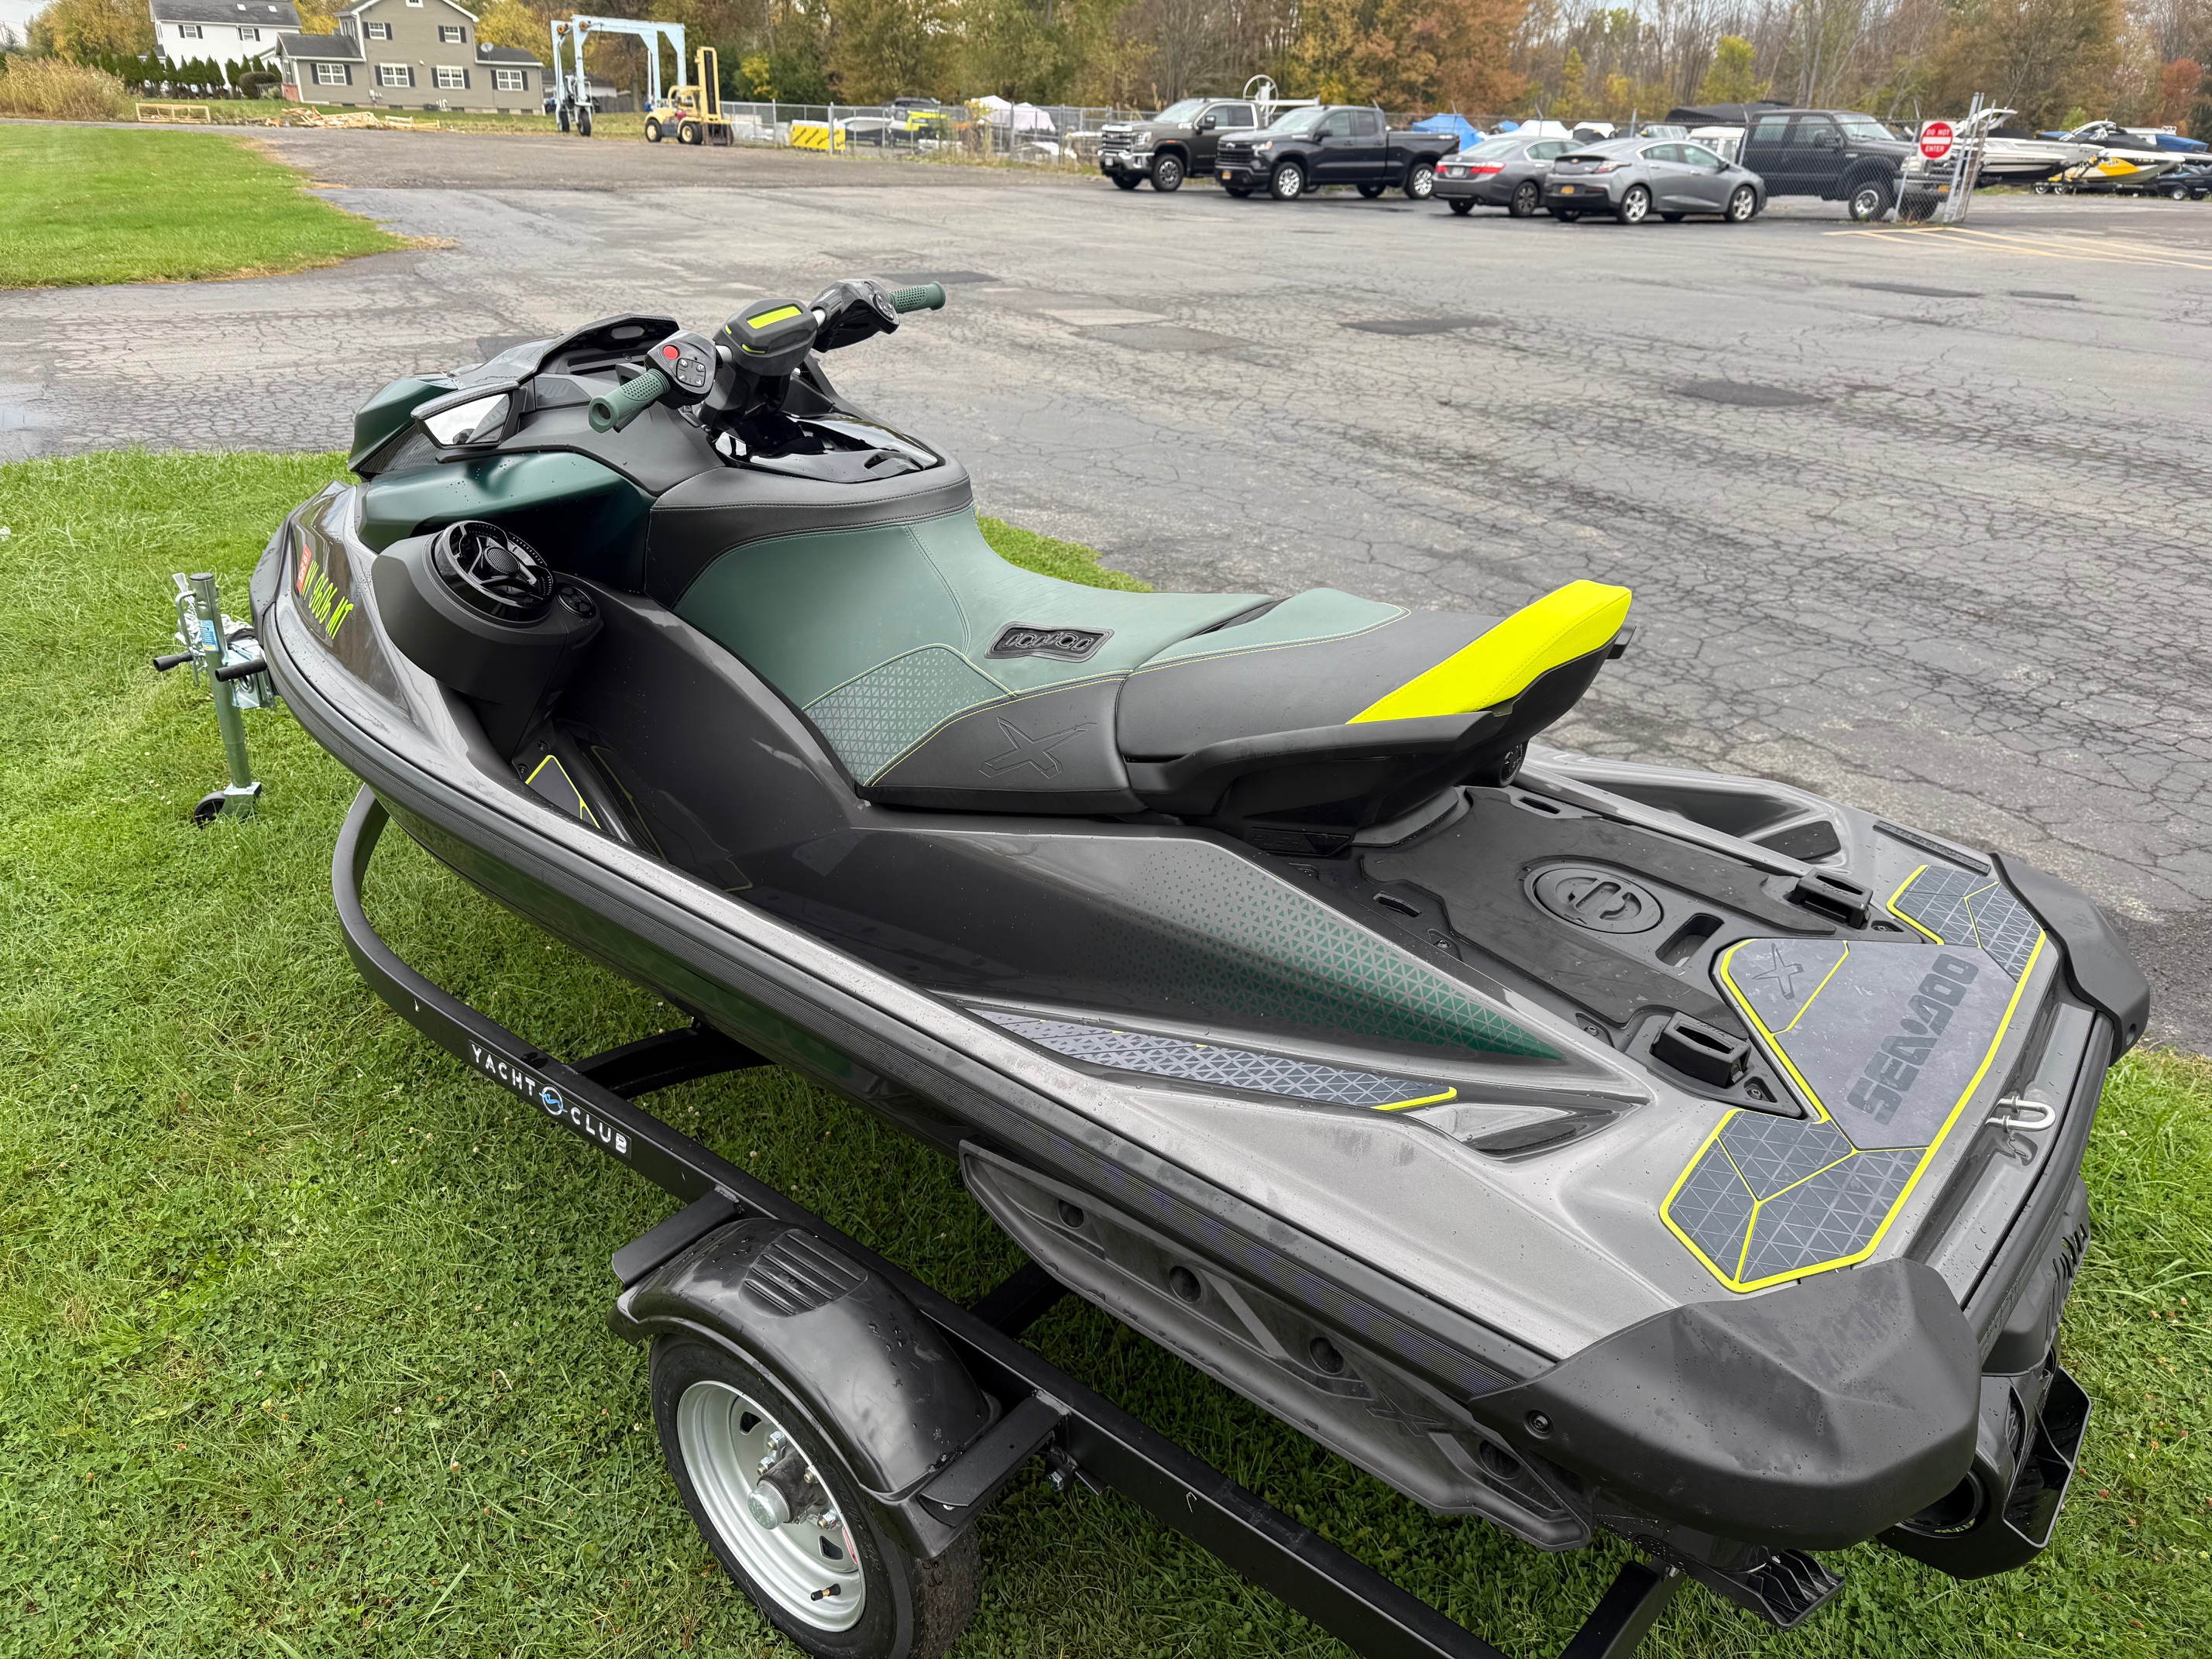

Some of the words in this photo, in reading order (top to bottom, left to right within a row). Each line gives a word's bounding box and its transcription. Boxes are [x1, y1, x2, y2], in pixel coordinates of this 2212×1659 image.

[308, 572, 338, 624] 9606
[472, 1044, 536, 1097] YACHT
[570, 1107, 627, 1154] CLUB
